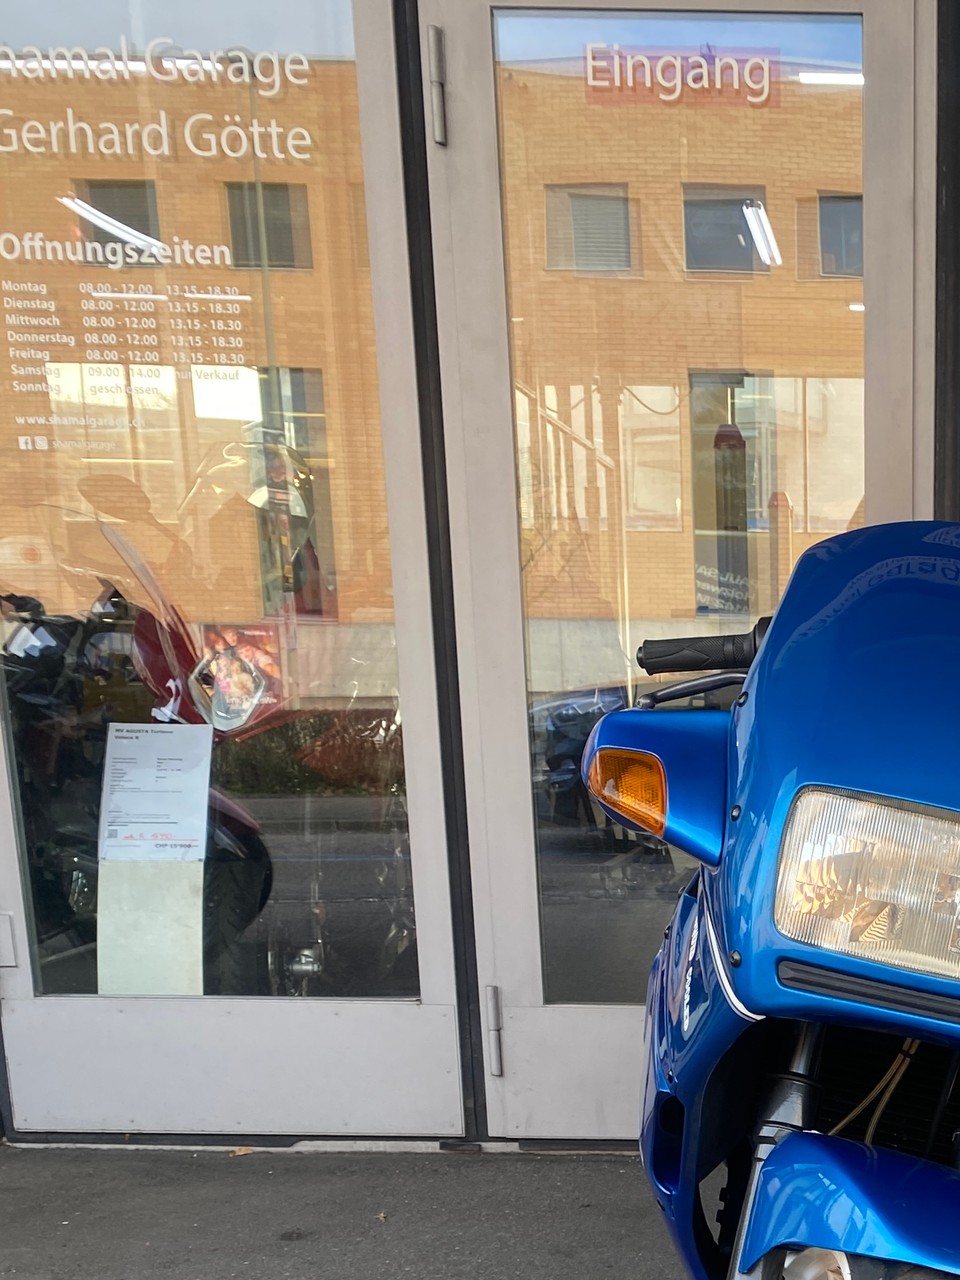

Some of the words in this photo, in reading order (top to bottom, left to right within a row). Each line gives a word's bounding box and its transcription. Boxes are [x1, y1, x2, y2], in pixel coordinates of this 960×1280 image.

[145, 36, 309, 96] Garage
[585, 41, 770, 103] Eingang
[0, 107, 170, 156] Gerhard
[184, 111, 312, 159] Götte
[2, 280, 47, 295] Montag
[79, 283, 112, 294] 08.00
[121, 284, 153, 294] 12.00
[166, 285, 197, 295] 13.15
[207, 286, 239, 296] 18.30
[3, 297, 56, 312] Dienstag
[81, 300, 113, 310] 08.00
[123, 301, 155, 312] 12.00
[168, 302, 199, 313] 13.15
[209, 303, 240, 314] 18.30
[5, 314, 60, 326] Mittwoch
[82, 316, 115, 327] 08.00
[125, 318, 156, 329] 12.00
[169, 318, 201, 329] 13.15
[210, 319, 242, 331] 18.30
[7, 330, 76, 347] Donnerstag
[84, 333, 117, 344] 08.00
[126, 334, 158, 345] 12.00
[171, 335, 202, 346] 13.15
[212, 336, 243, 348] 18.30
[9, 347, 50, 362] Freitag
[86, 350, 118, 361] 08.00
[127, 351, 159, 362] 12.00
[172, 352, 203, 363] 13.15
[213, 353, 245, 364] 18.30
[10, 363, 61, 378] Samstag
[88, 366, 120, 377] 09.00
[129, 368, 160, 378] 14.00
[196, 369, 240, 380] Verkauf
[12, 381, 61, 395] Sonntag
